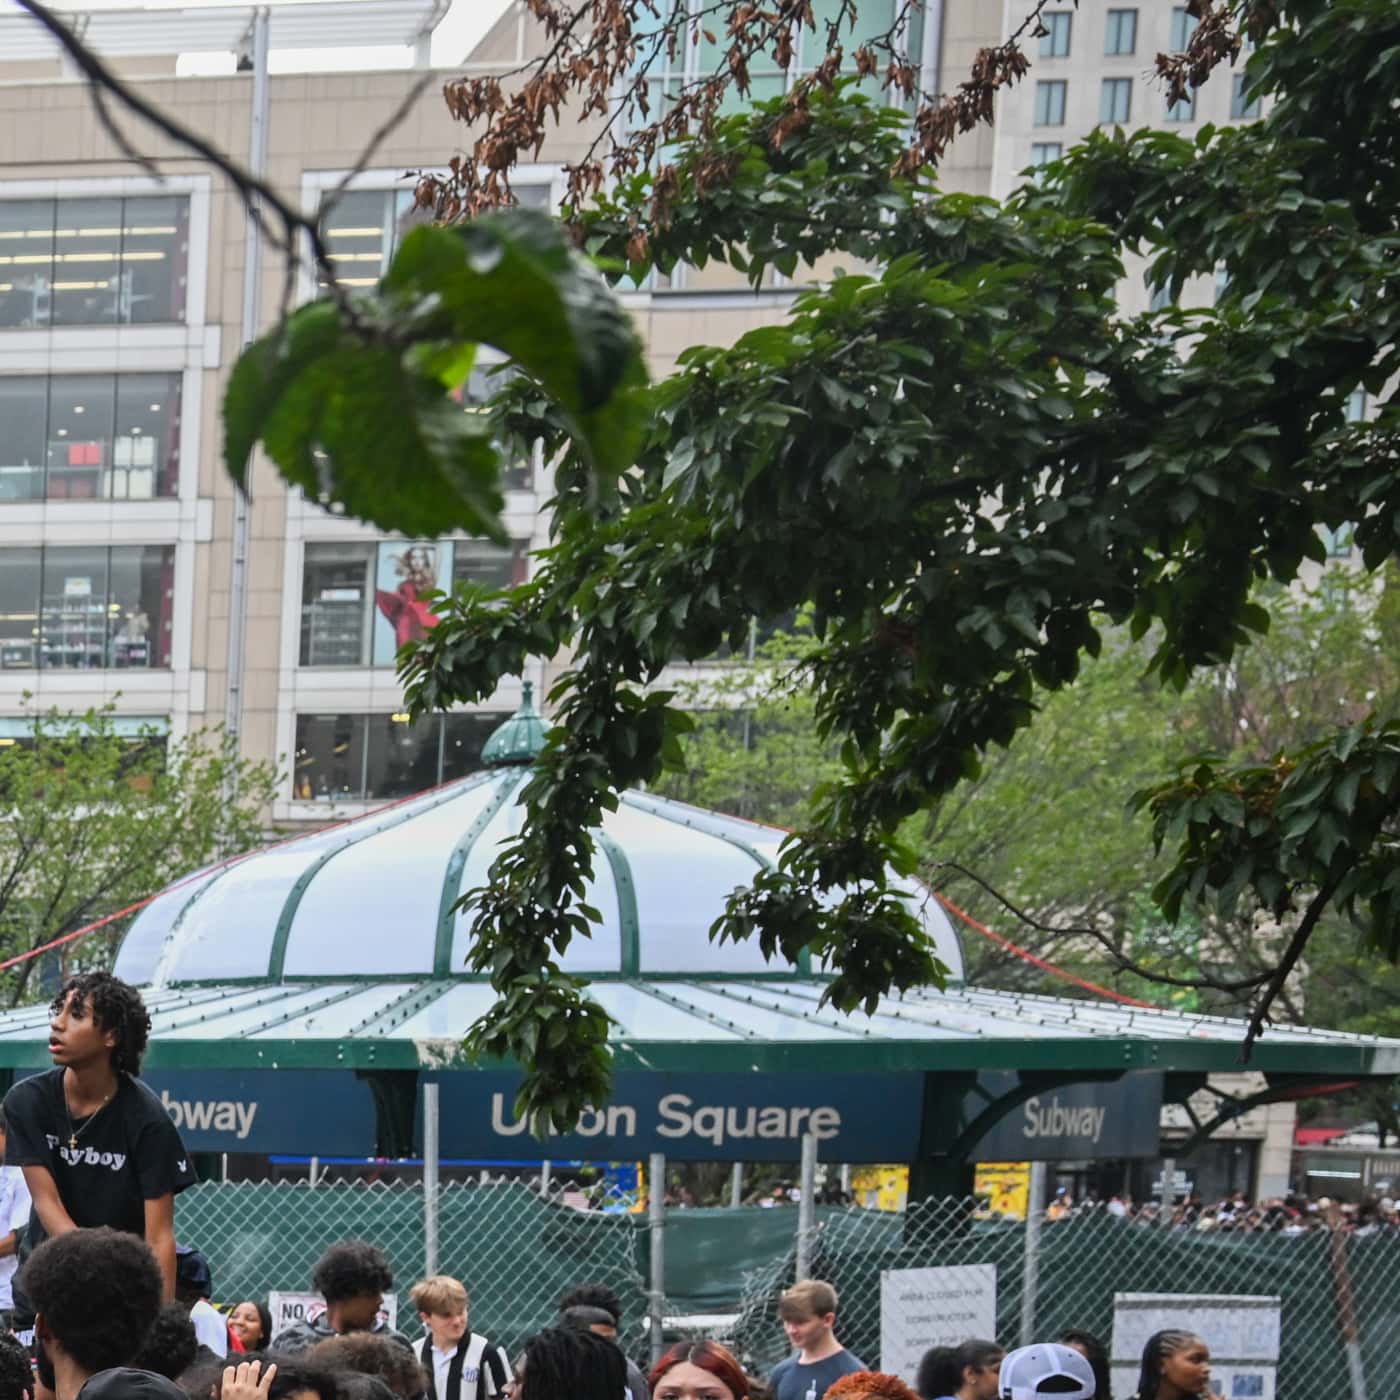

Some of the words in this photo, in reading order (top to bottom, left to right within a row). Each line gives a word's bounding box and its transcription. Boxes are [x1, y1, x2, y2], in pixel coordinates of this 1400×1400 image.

[160, 1090, 258, 1139] bway
[656, 1093, 841, 1146] Square
[1023, 1096, 1105, 1143] Subway
[282, 1303, 305, 1319] NO
